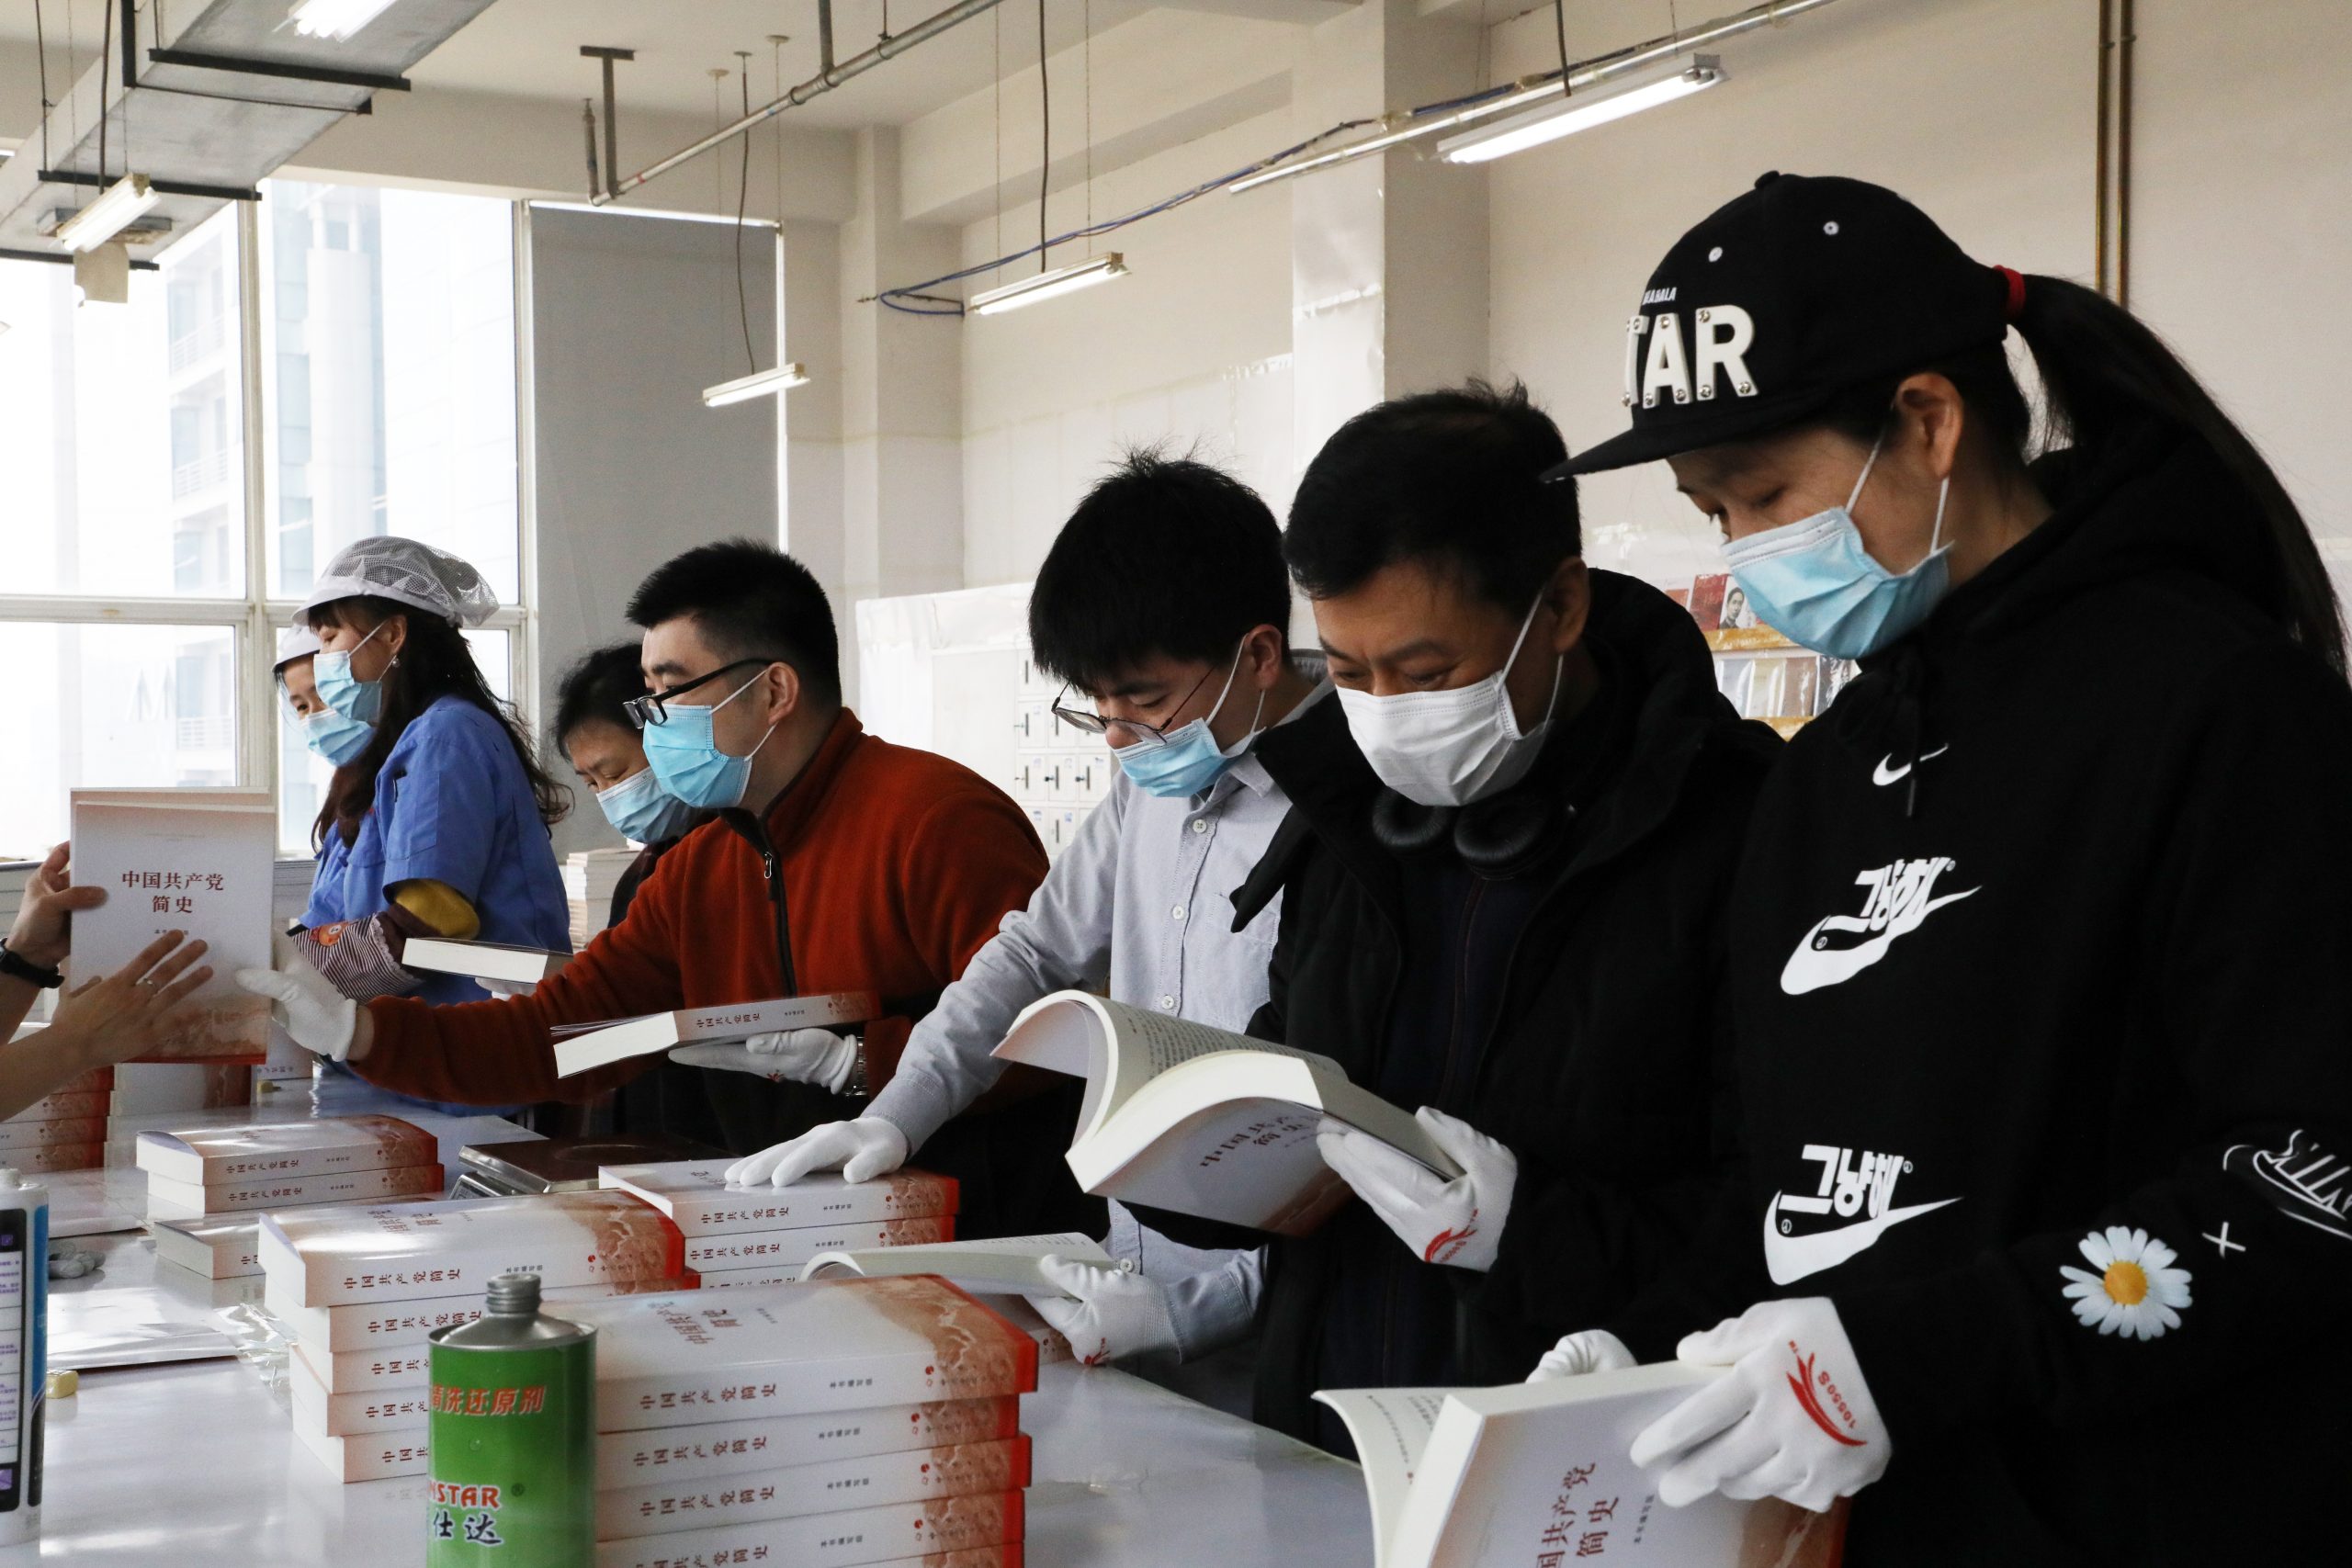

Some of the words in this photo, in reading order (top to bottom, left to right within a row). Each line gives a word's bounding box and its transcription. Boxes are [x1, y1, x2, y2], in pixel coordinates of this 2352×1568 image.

[121, 870, 224, 891] 中国共产党
[153, 895, 193, 914] 简史
[226, 1158, 300, 1175] 中国共产党简史
[228, 1187, 302, 1201] 中国共产党简史
[701, 1206, 789, 1225] 中国共产党简史
[689, 1243, 781, 1261] 中国共产党简史
[344, 1268, 461, 1290] 中国共产党简史
[368, 1310, 482, 1333] 中国共产党简史
[640, 1382, 777, 1410] 中国共产党简史
[633, 1435, 767, 1467] 中国共产党简史
[639, 1485, 775, 1517] 中国共产党简史
[1576, 1495, 1620, 1558] 简史
